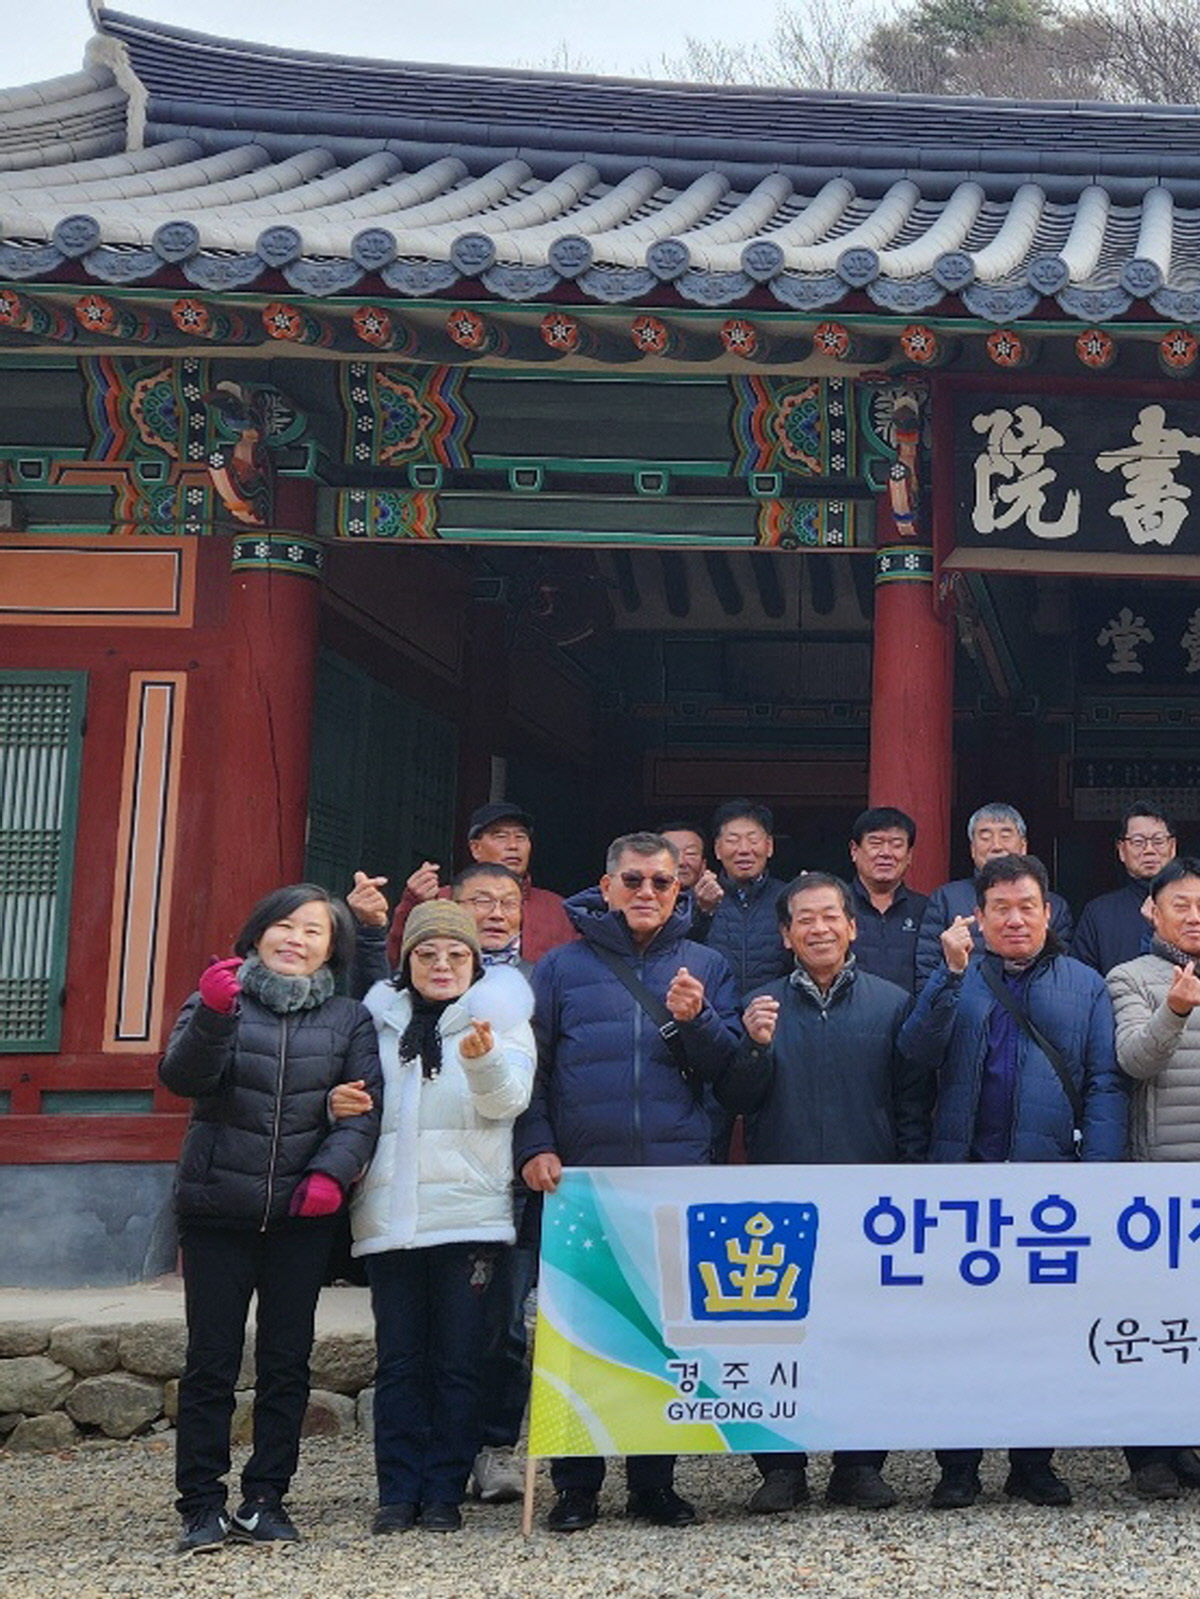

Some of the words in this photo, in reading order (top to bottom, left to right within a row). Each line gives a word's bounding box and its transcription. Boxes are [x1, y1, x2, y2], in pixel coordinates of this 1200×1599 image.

[863, 1194, 1091, 1286] 안강읍
[668, 1403, 763, 1421] GYEONG
[769, 1402, 797, 1419] JU
